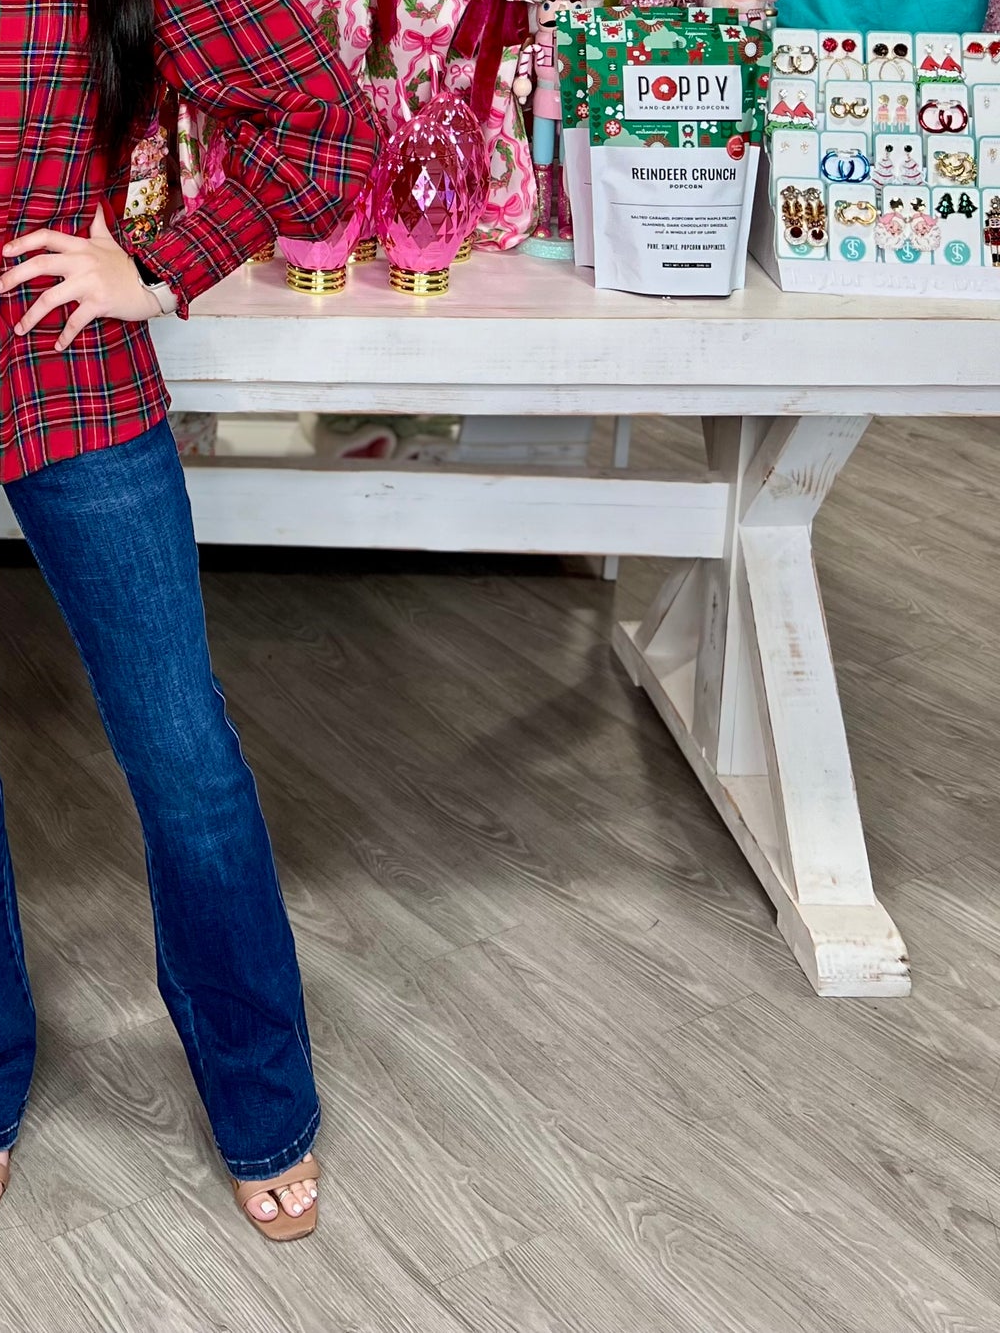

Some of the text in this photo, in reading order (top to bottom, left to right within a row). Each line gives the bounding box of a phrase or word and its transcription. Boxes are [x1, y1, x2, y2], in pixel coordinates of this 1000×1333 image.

[637, 75, 728, 101] POPPY
[631, 167, 736, 181] REINDEER CRUNCH
